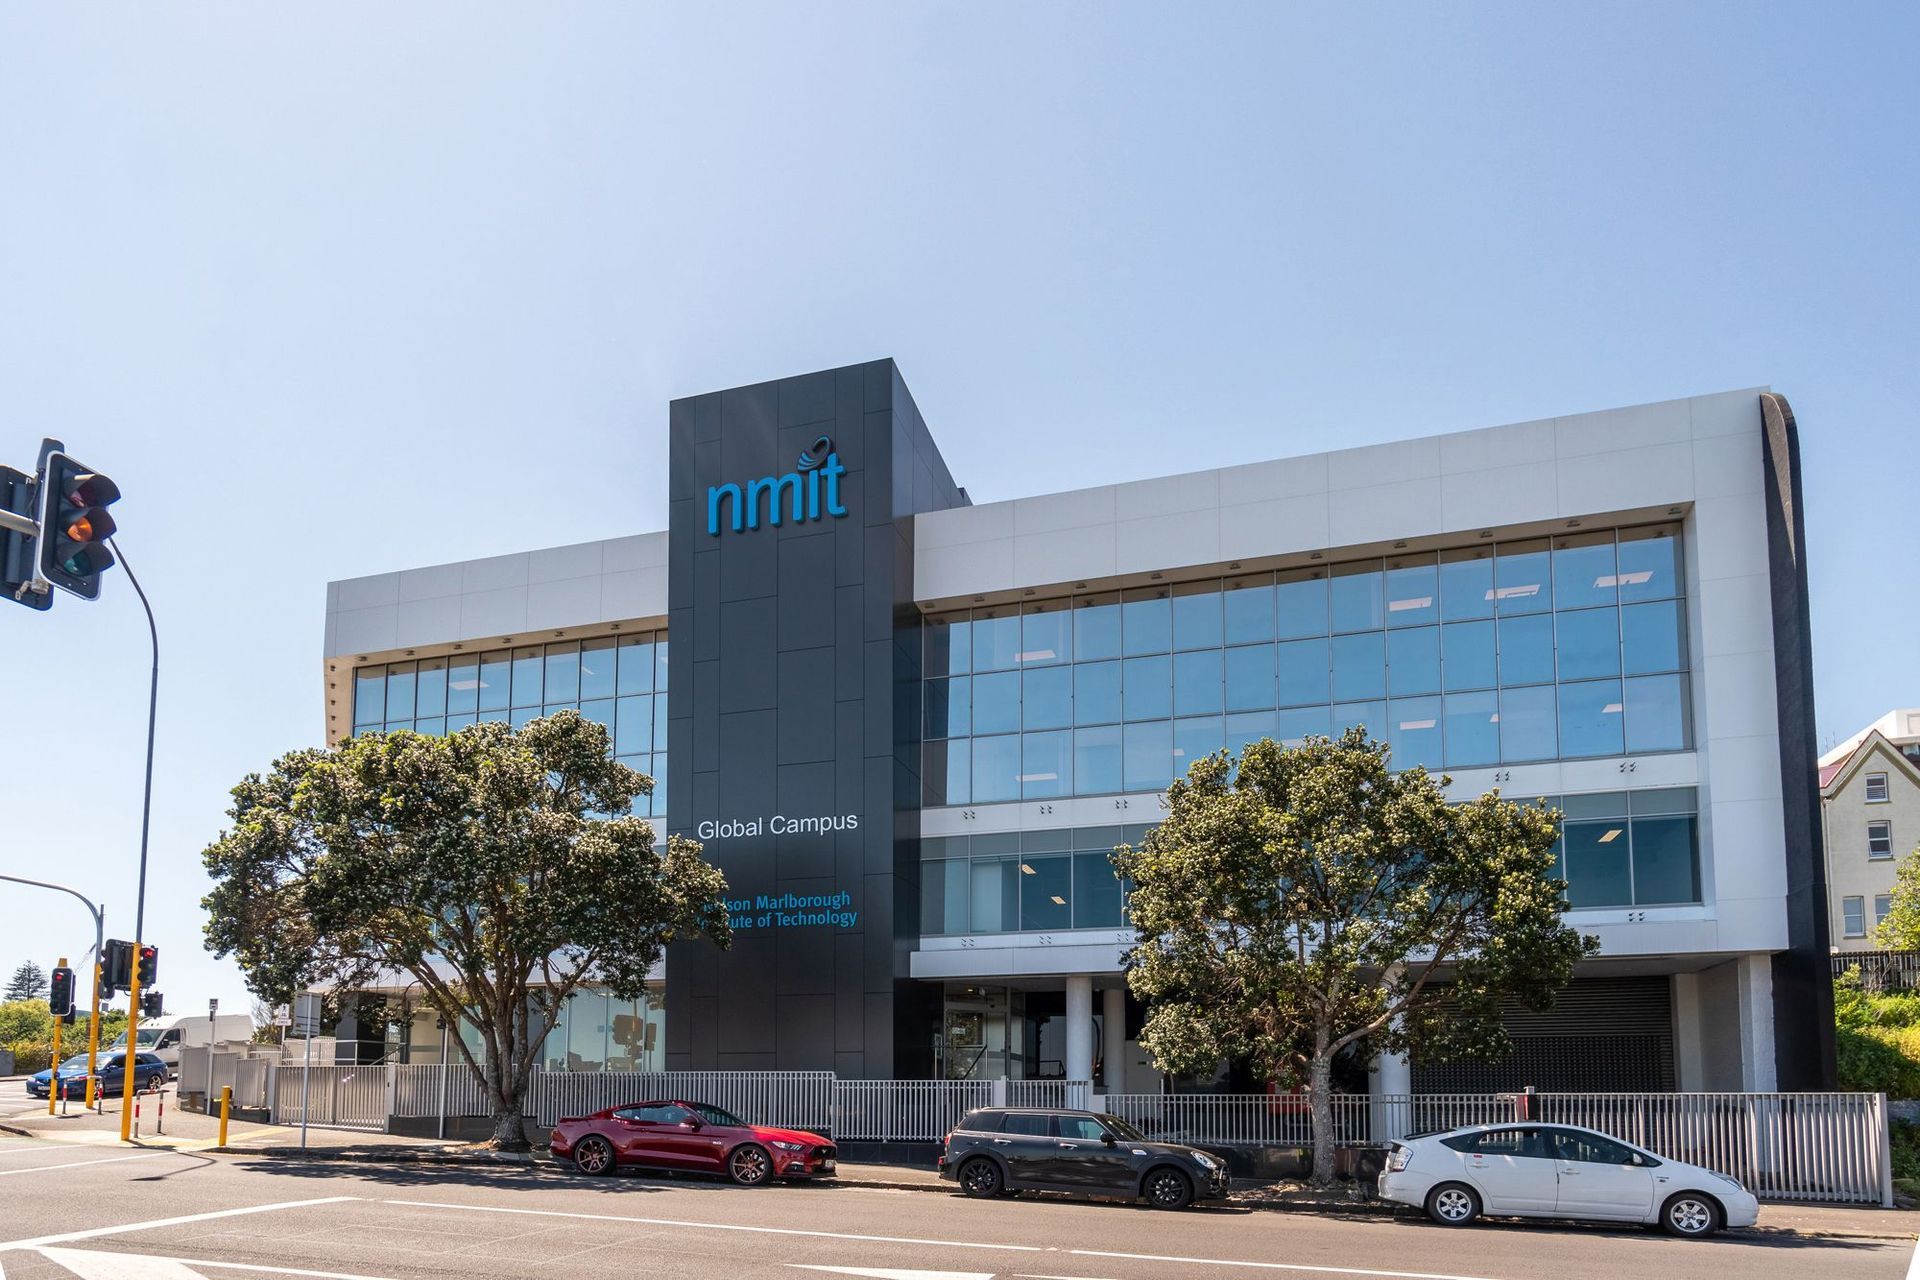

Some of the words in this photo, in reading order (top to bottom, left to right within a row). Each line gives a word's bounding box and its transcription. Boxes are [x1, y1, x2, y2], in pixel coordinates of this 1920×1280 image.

[708, 436, 848, 536] nmit
[698, 817, 762, 839] Global
[770, 814, 858, 836] Campus
[756, 890, 850, 910] Marlborough
[757, 912, 771, 927] of
[775, 909, 858, 928] Technology
